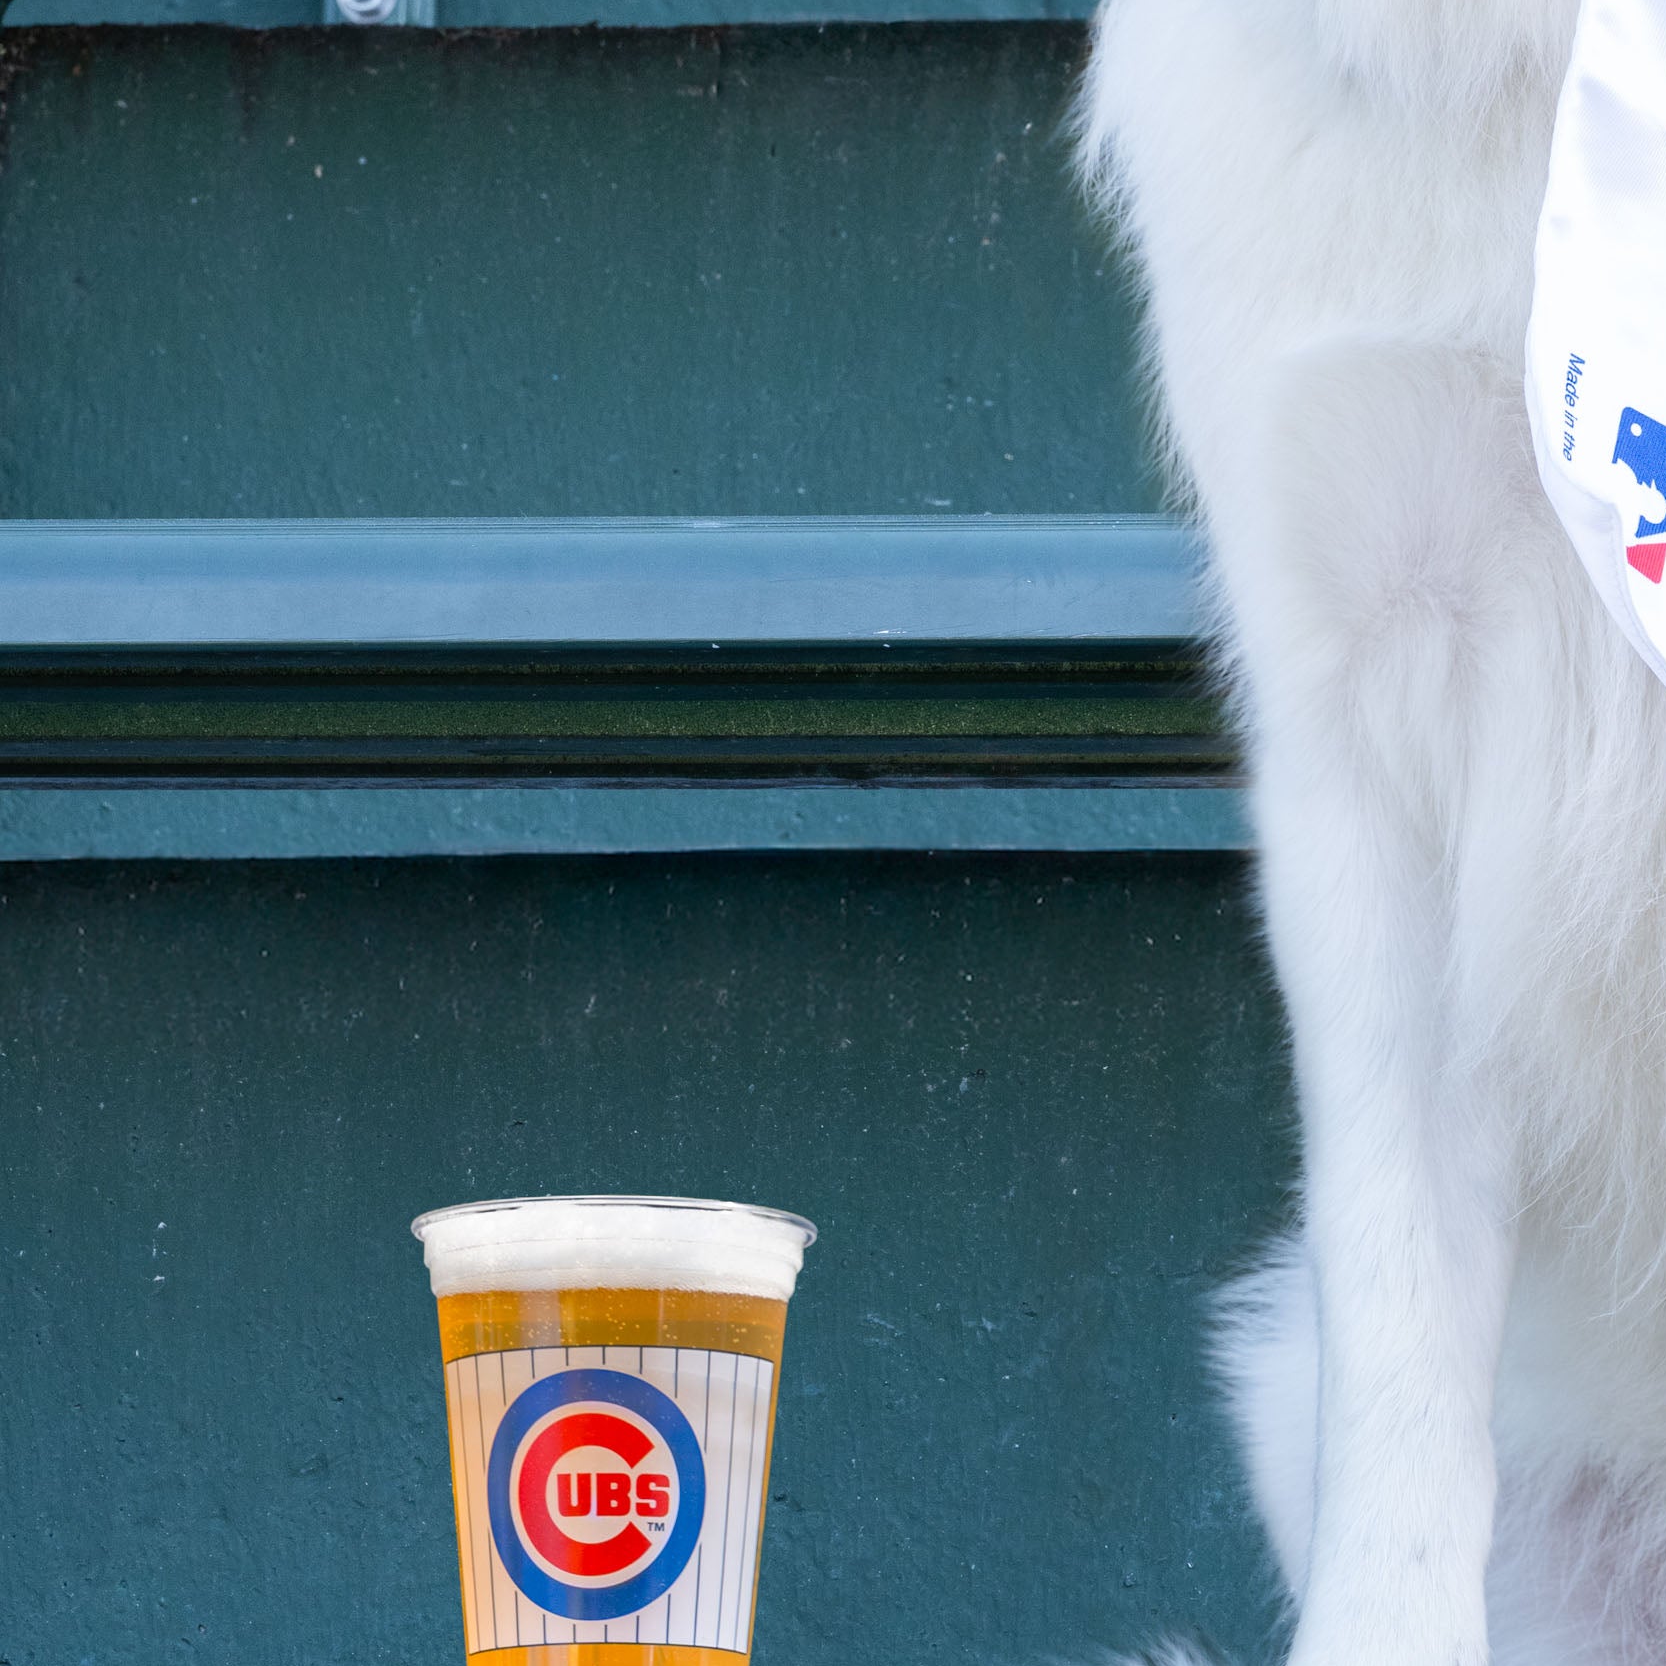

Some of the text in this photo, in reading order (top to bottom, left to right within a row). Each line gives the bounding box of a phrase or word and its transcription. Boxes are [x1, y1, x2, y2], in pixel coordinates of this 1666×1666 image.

[1562, 352, 1585, 461] Made in the
[519, 1413, 670, 1576] CUBS
